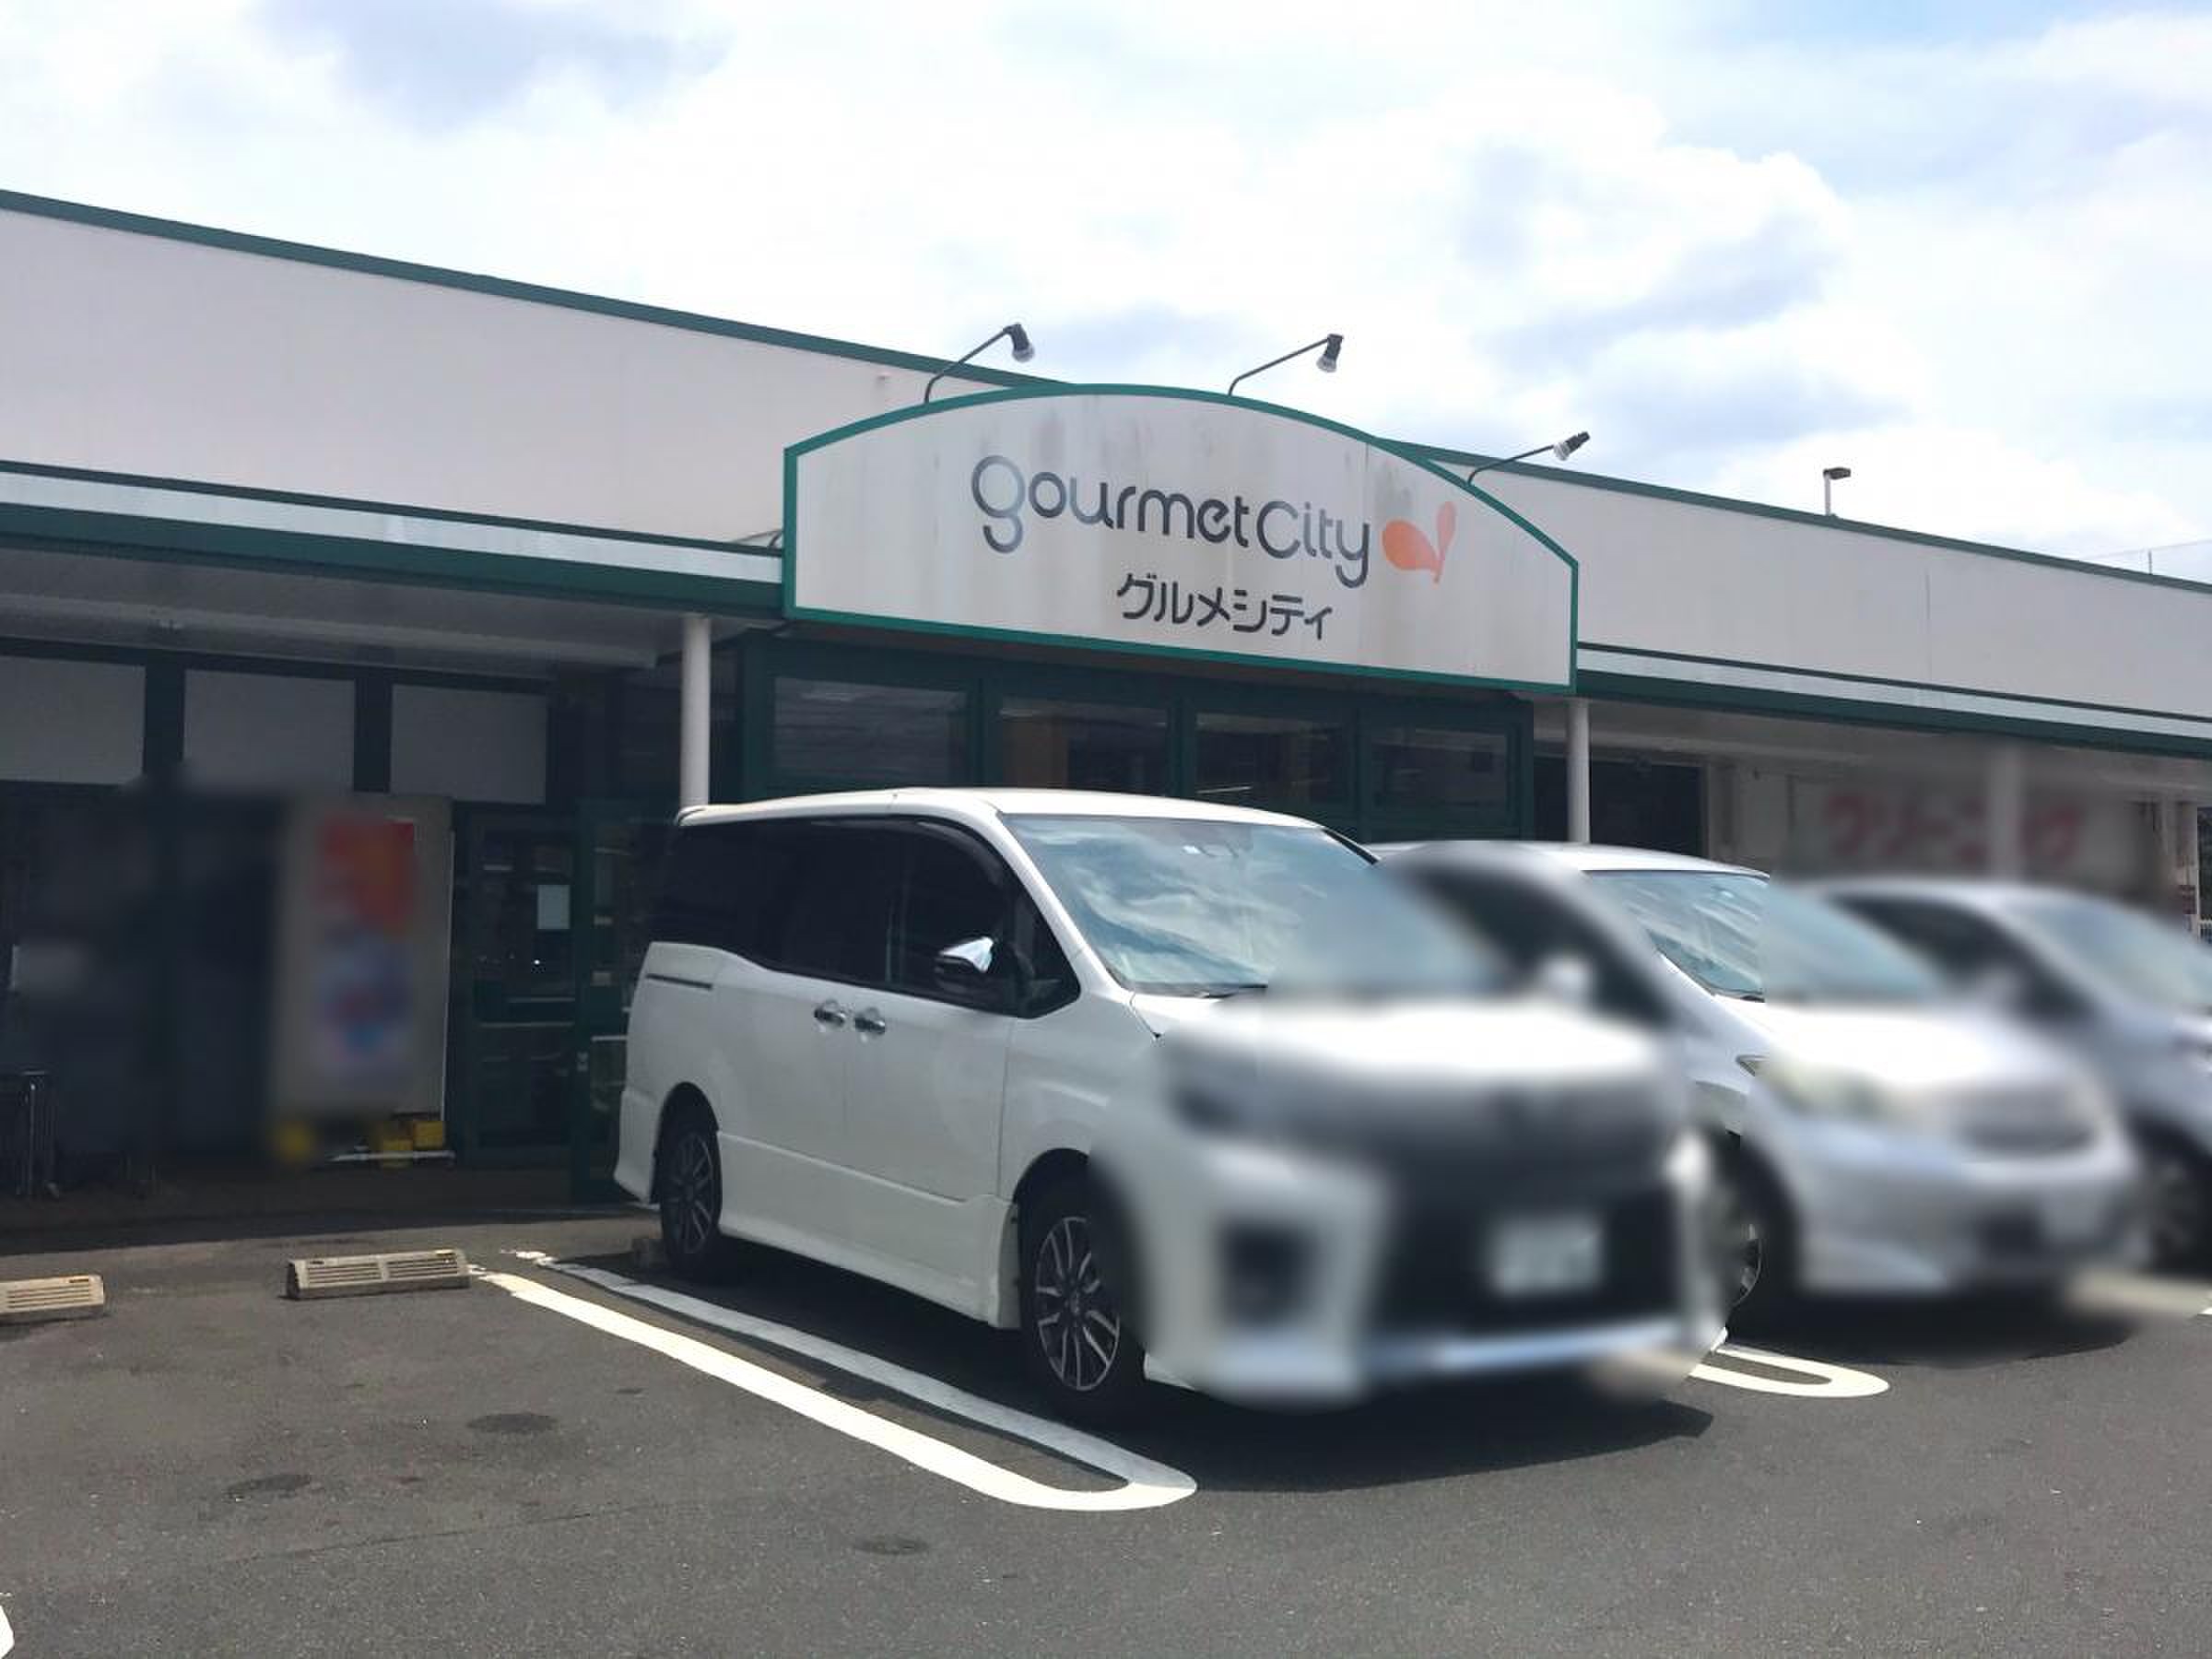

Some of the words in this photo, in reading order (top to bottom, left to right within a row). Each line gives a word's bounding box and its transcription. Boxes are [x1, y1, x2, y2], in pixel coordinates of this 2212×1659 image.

[1116, 572, 1333, 640] グルメシティ
